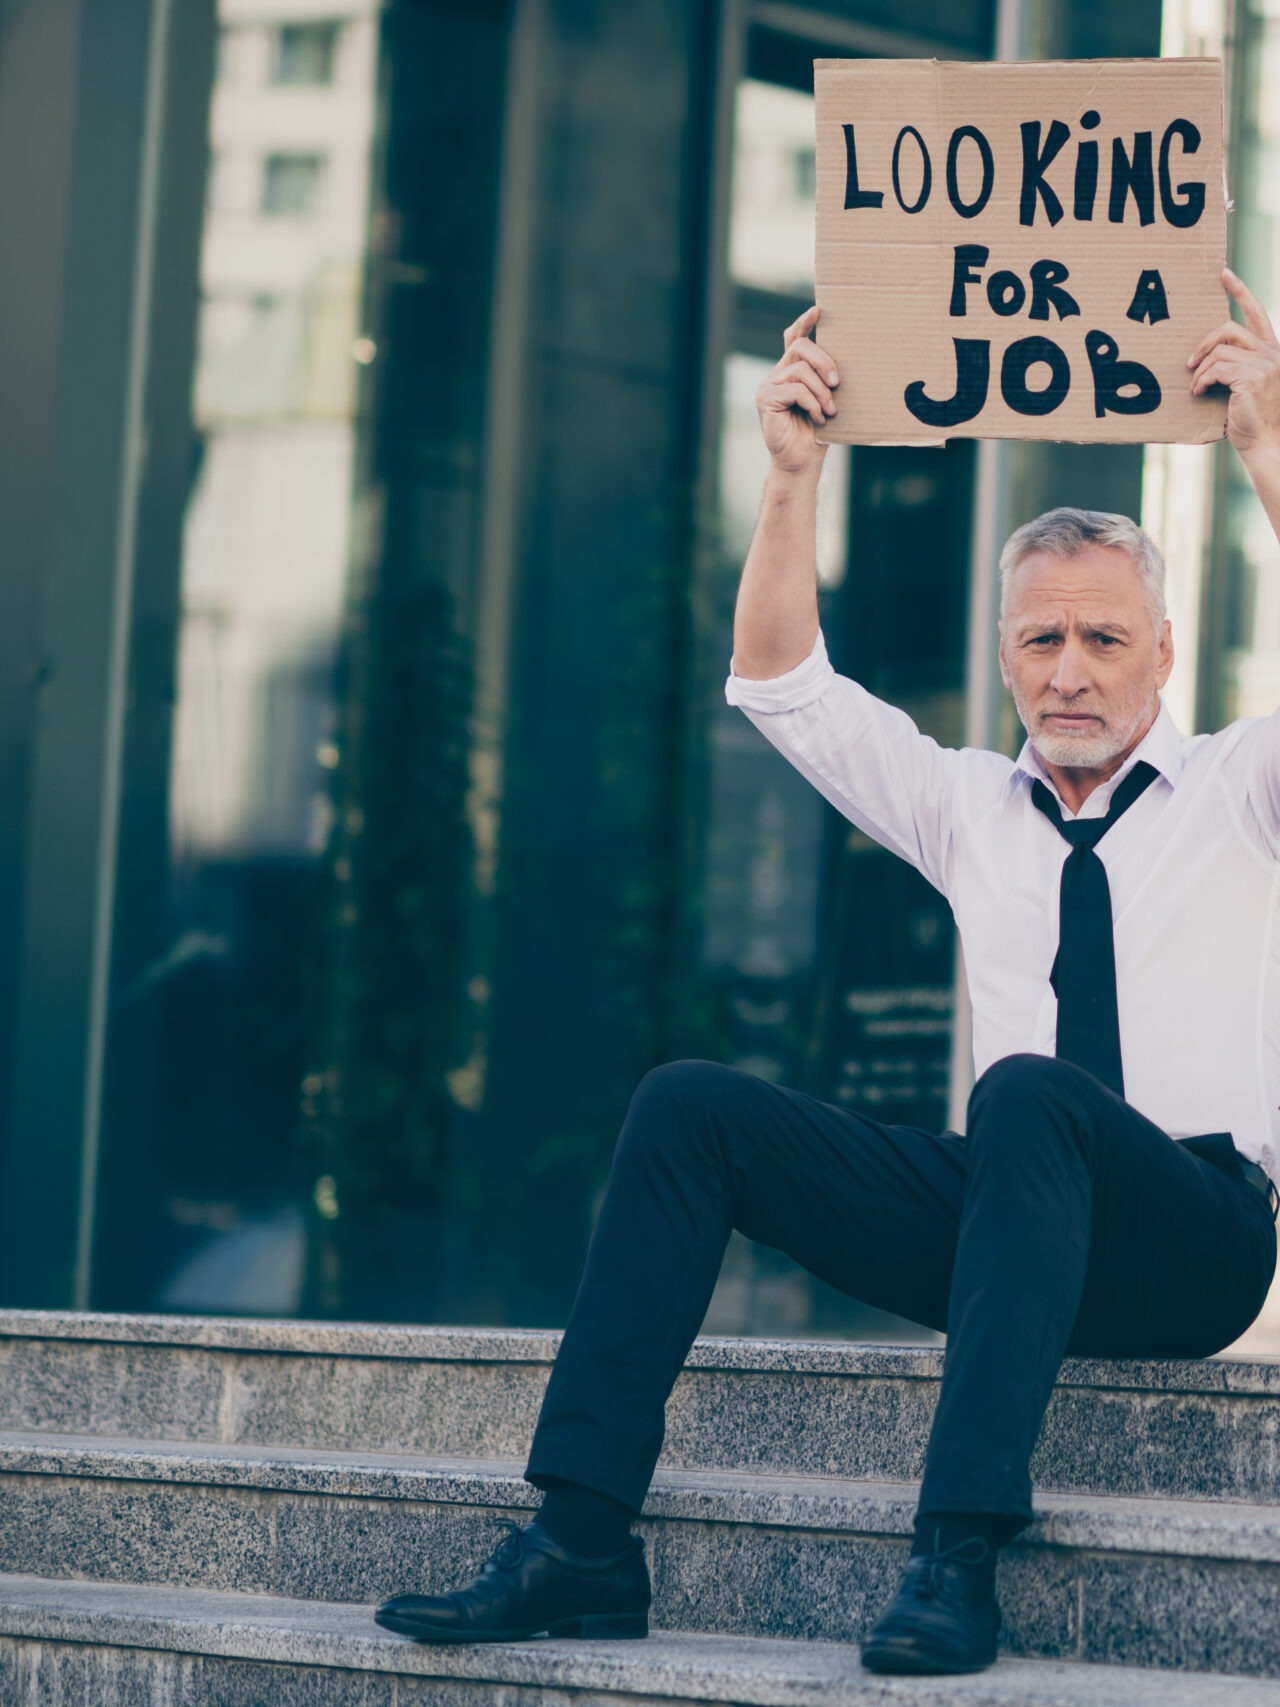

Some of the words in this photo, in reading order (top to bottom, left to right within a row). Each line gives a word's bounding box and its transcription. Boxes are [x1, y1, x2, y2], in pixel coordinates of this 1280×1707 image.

[949, 243, 1081, 322] FOR
[1125, 268, 1171, 326] A
[903, 329, 1163, 428] JOB
